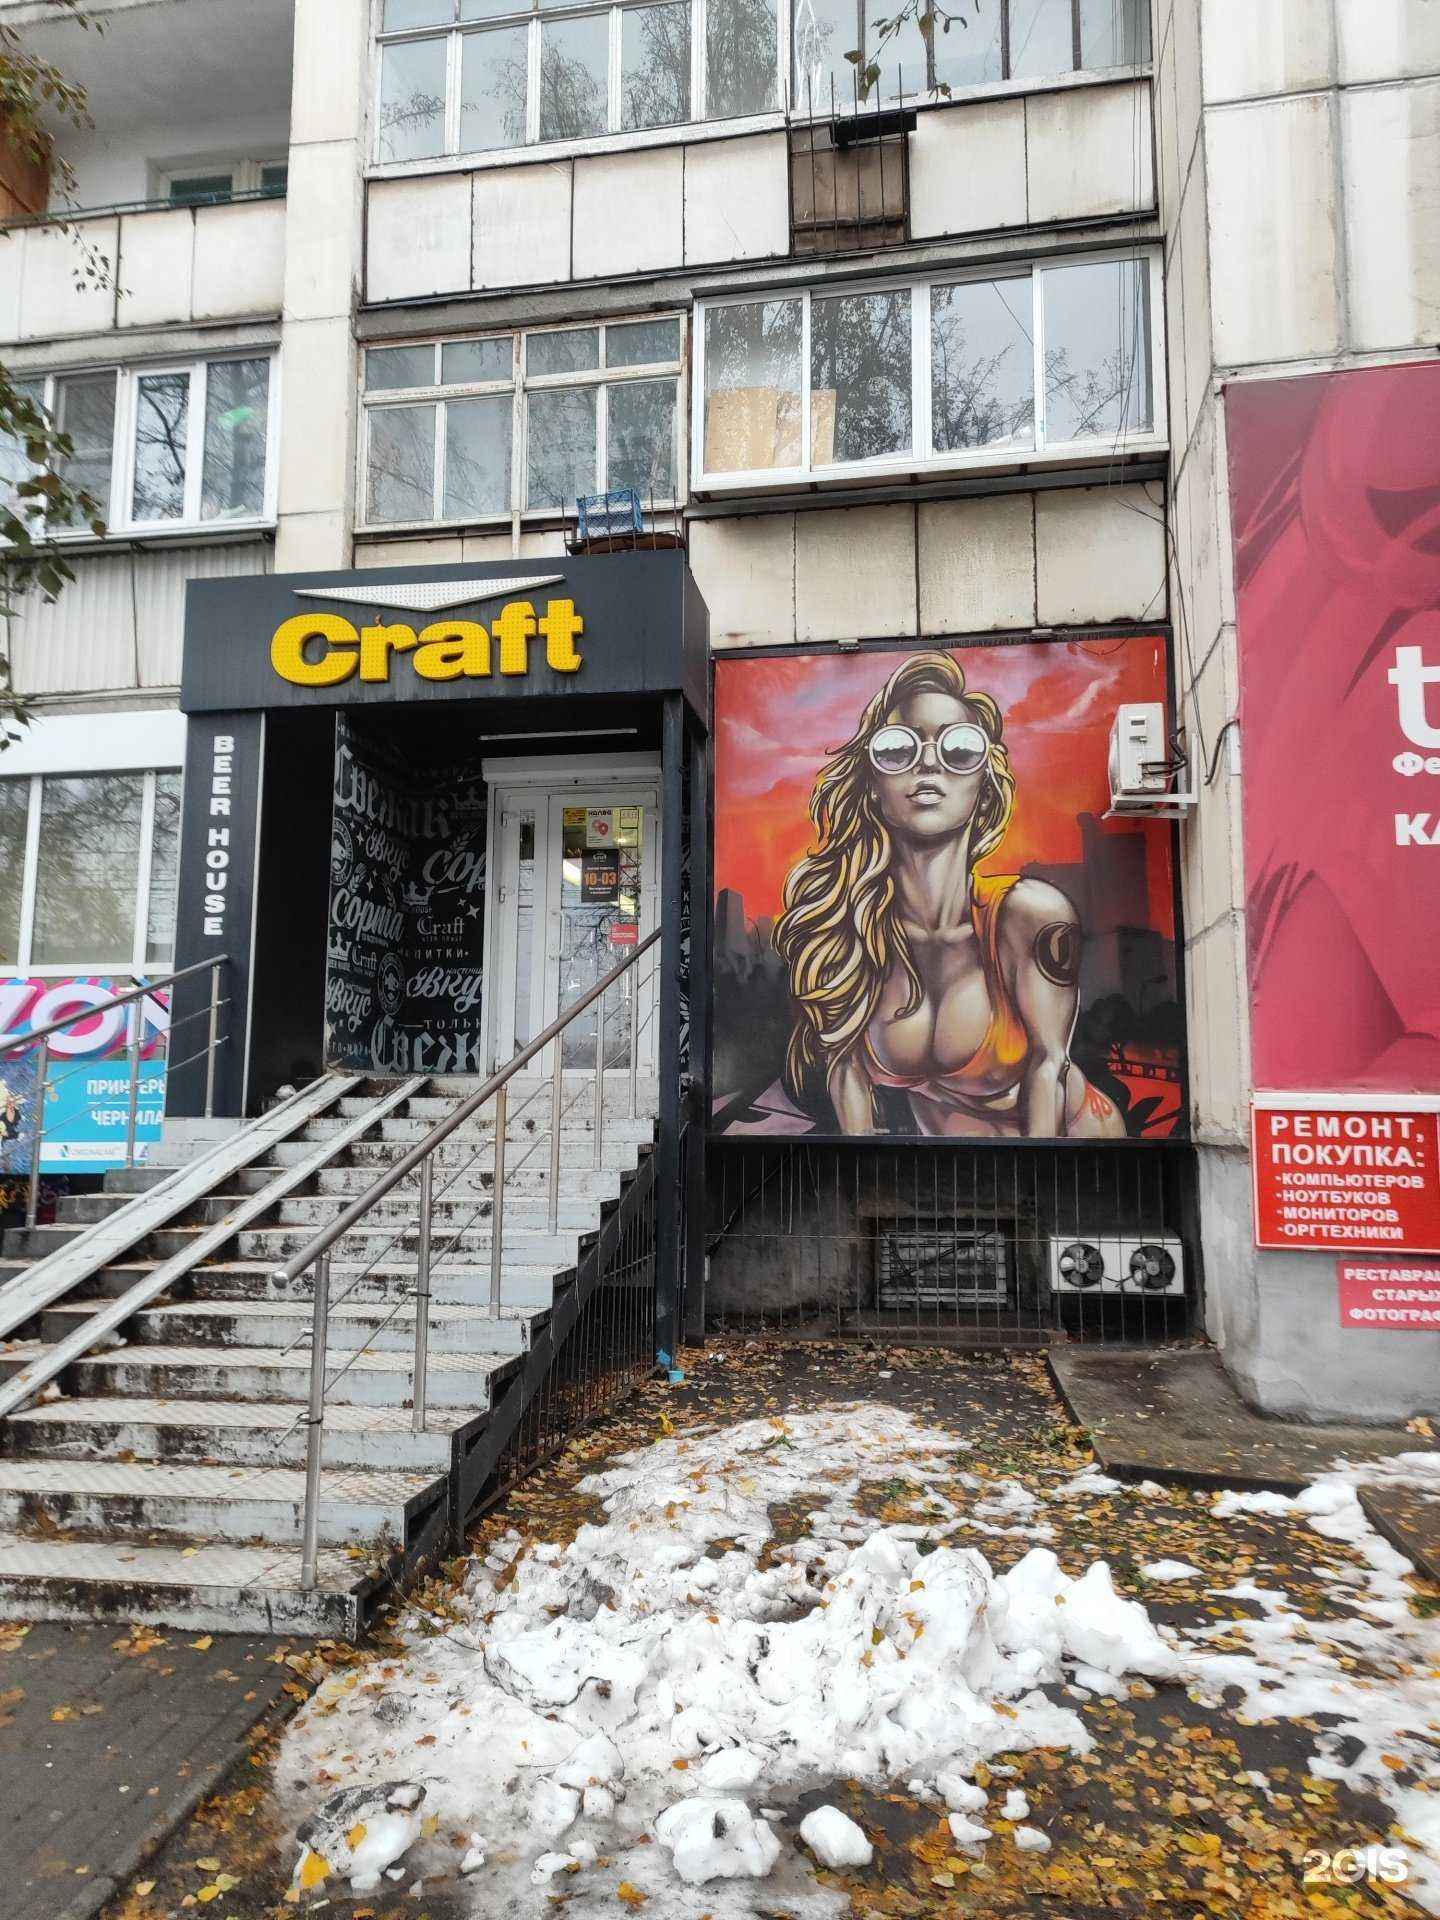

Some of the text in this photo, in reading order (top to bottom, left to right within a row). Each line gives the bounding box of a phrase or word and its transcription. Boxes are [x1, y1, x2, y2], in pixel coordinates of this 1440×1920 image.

[270, 599, 584, 687] Craft
[203, 736, 235, 936] BEER HOUSE
[584, 871, 617, 886] 10-03
[417, 916, 465, 935] Craft
[407, 966, 483, 1013] Вку
[1270, 1116, 1425, 1143] РЕМОНТ,
[1271, 1143, 1426, 1168] ПОКУПКА:
